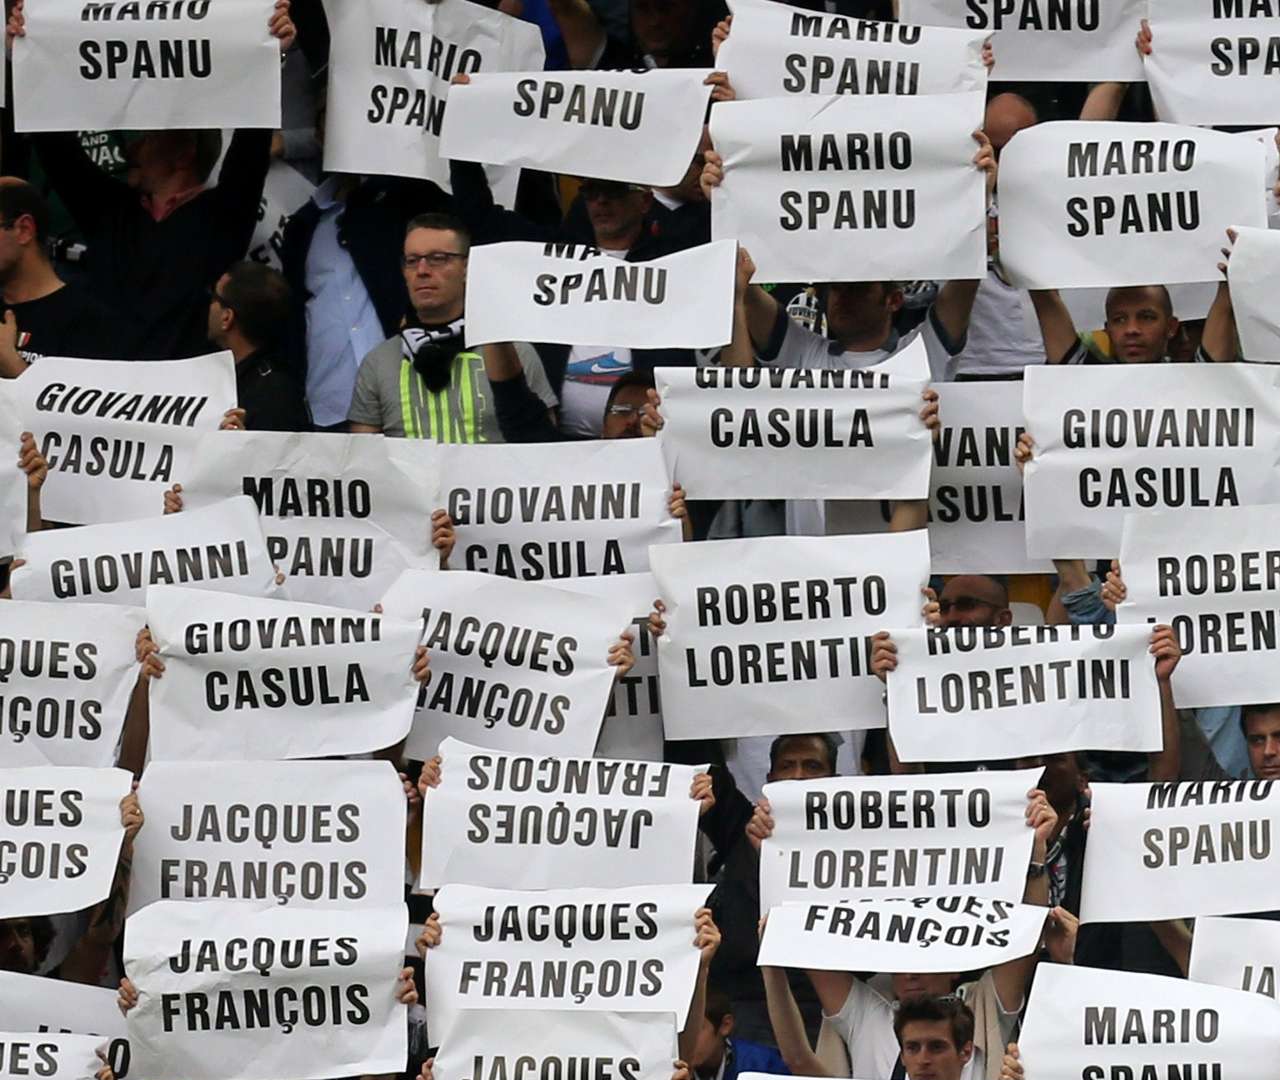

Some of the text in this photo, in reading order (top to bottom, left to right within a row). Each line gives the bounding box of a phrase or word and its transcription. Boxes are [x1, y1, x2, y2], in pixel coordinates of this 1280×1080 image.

[78, 38, 212, 81] SPANU
[783, 53, 920, 96] SPANU
[513, 79, 645, 131] SPANU
[780, 131, 913, 172] MARIO
[1067, 139, 1196, 178] MARIO
[533, 265, 667, 306] SPANU
[35, 382, 209, 427] GIOVANNI
[710, 407, 875, 449] CASULA
[1062, 407, 1254, 449] GIOVANNI
[445, 482, 641, 529] GIOVANNI
[1078, 466, 1240, 508] CASULA
[50, 540, 249, 600] GIOVANNI
[464, 539, 627, 582] CASULA
[696, 575, 887, 627] ROBERTO
[184, 616, 381, 656] GIOVANNI
[916, 658, 1130, 714] LORENTINI
[467, 755, 671, 797] FRANÇOIS
[170, 803, 360, 850] JACQUES
[467, 801, 653, 850] JACQUES
[805, 788, 991, 831] ROBERTO
[1143, 819, 1271, 869] SPANU
[804, 903, 1010, 948] FRANÇOIS
[168, 937, 358, 978] JACQUES
